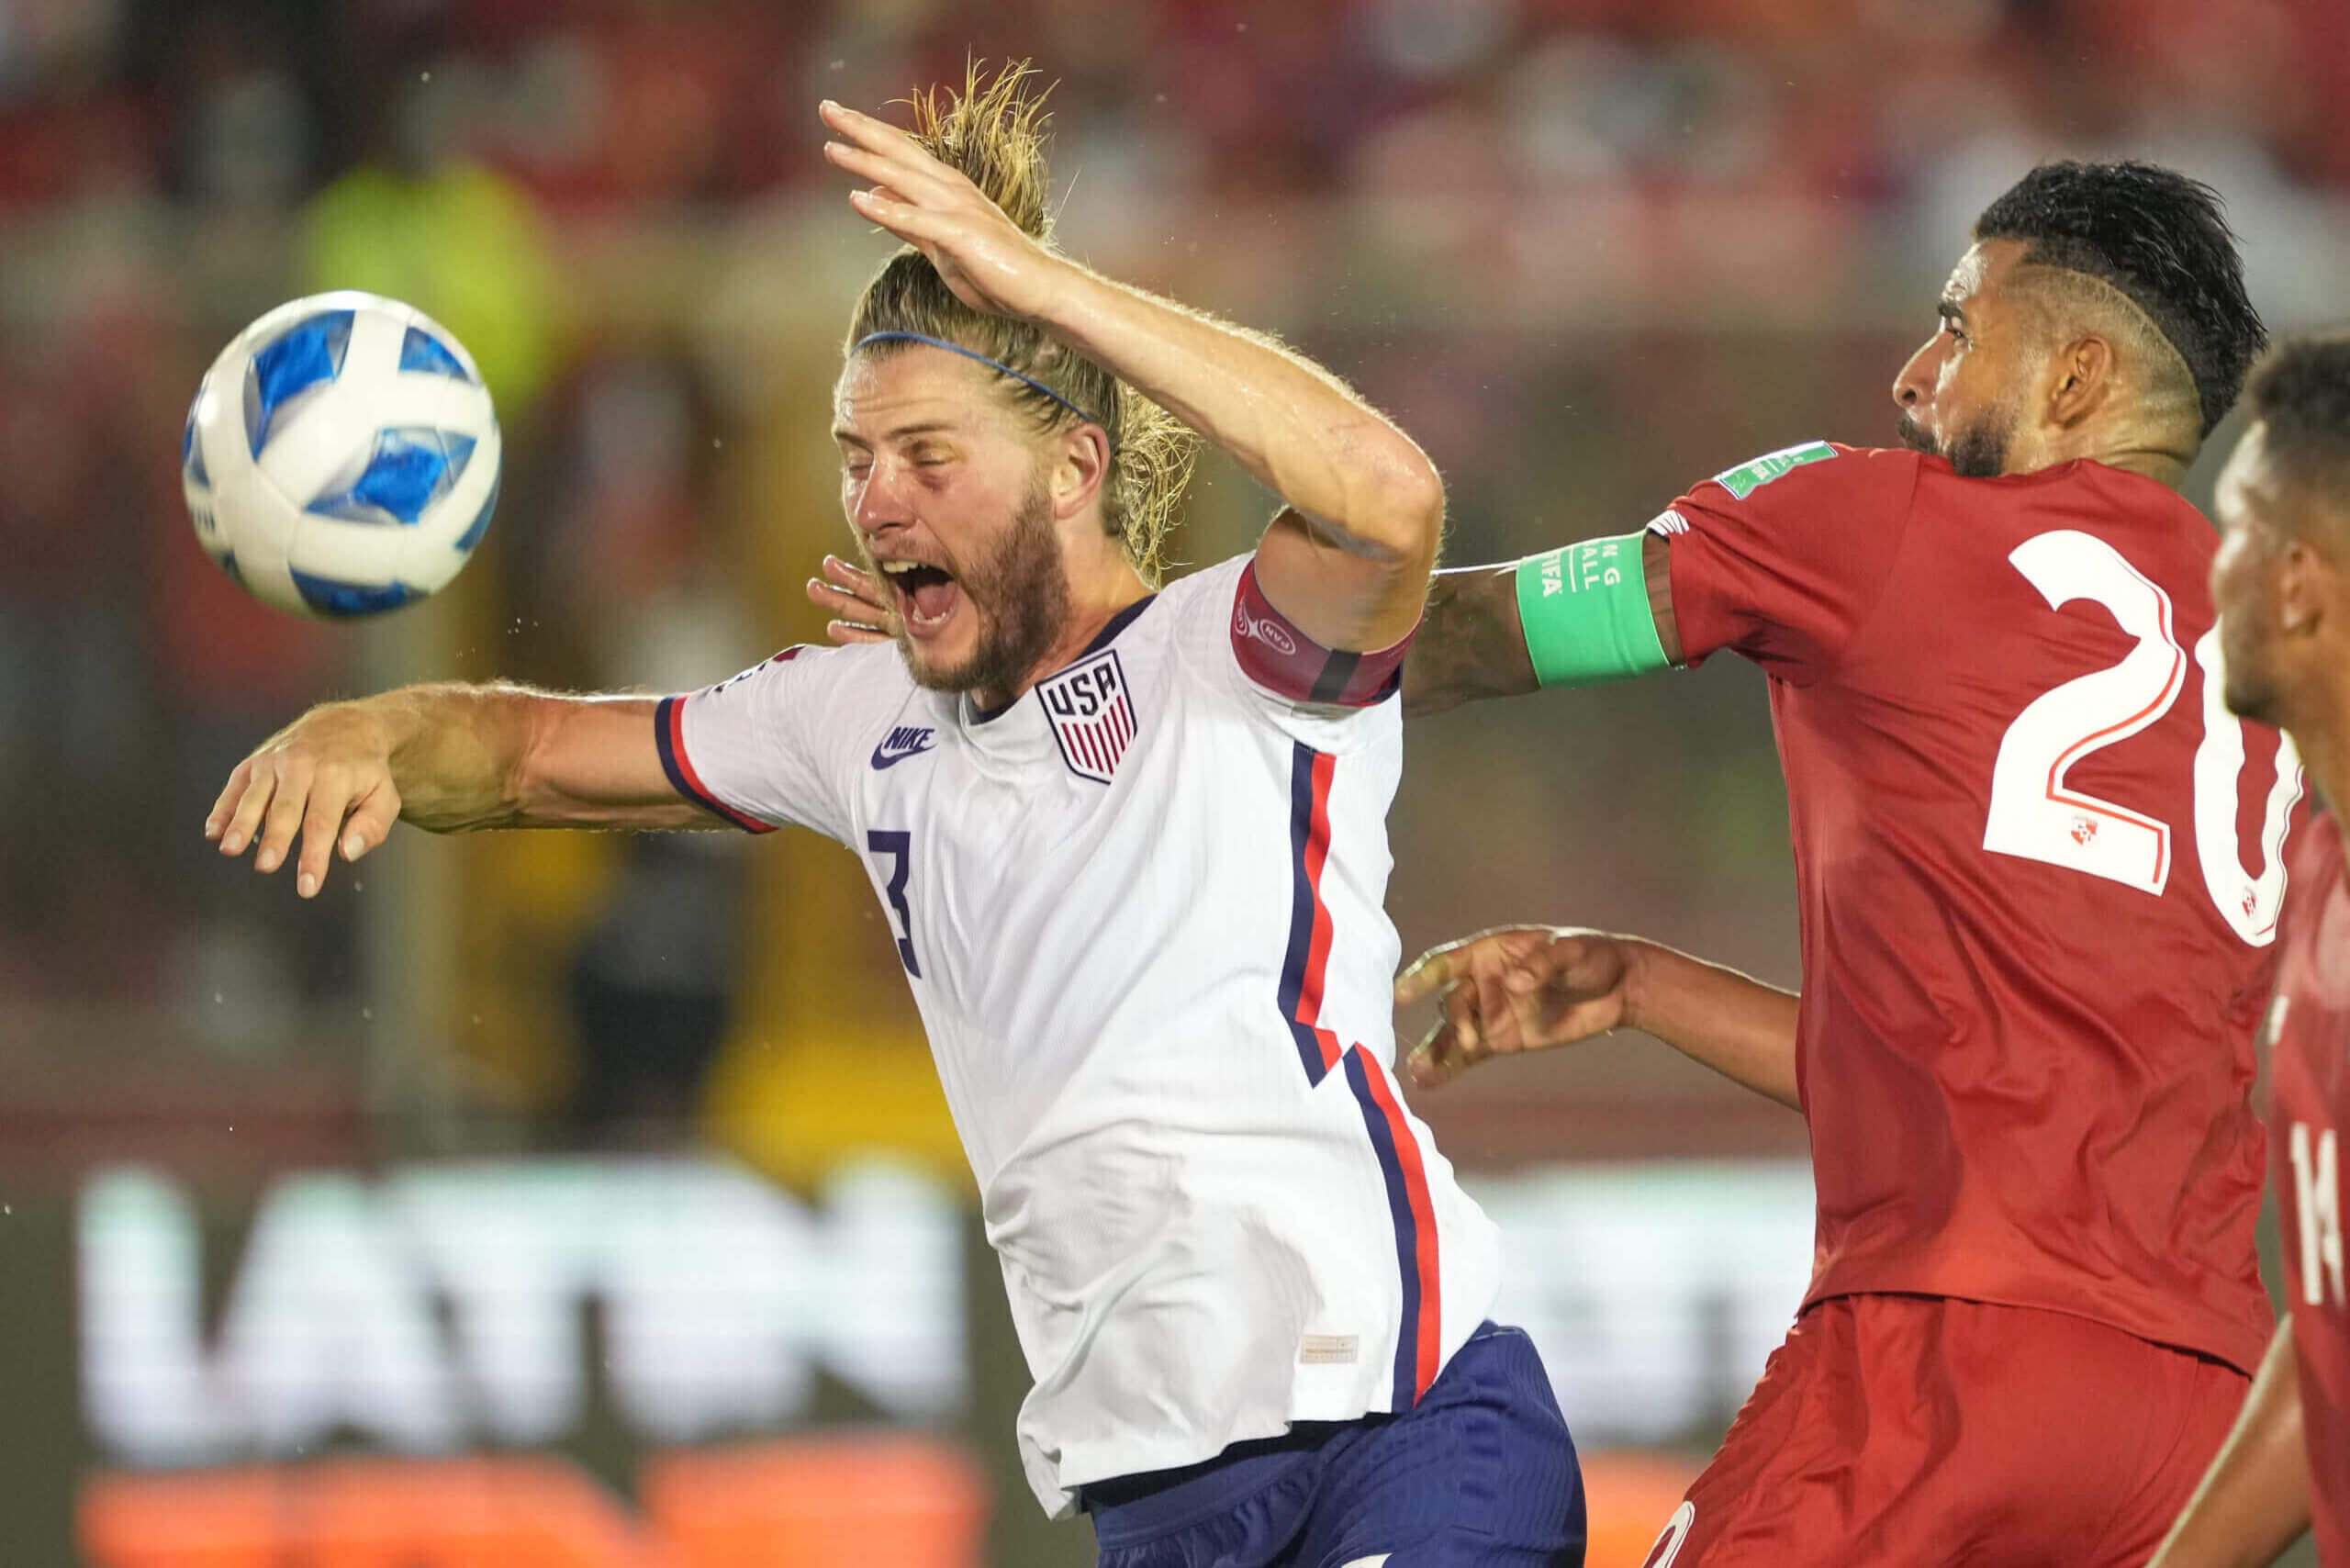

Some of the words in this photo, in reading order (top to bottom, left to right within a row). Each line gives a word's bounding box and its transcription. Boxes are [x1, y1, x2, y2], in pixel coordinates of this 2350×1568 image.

[1581, 543, 1600, 590] ALL
[1047, 662, 1116, 716] USA
[884, 726, 935, 750] NIKE
[1983, 529, 2307, 948] 20
[867, 830, 923, 980] 3
